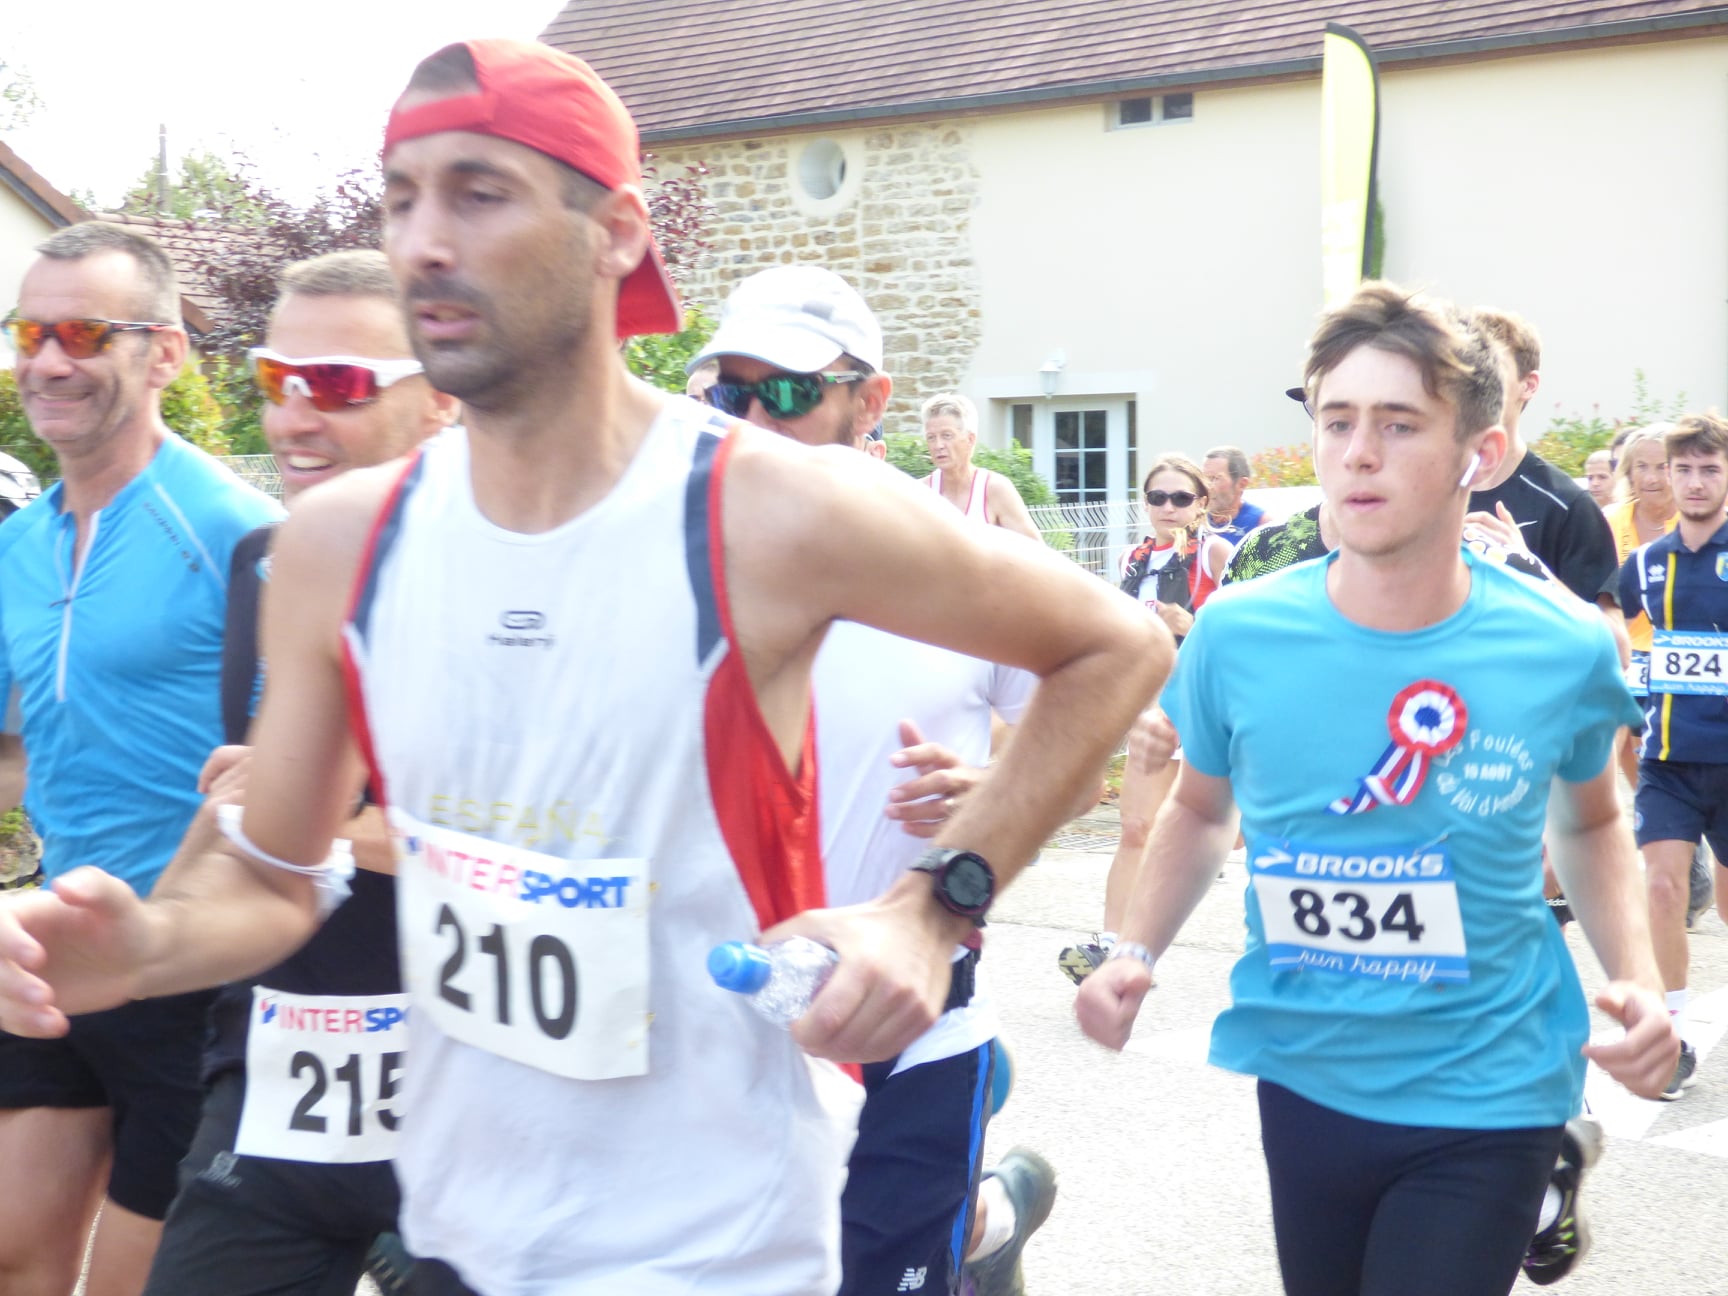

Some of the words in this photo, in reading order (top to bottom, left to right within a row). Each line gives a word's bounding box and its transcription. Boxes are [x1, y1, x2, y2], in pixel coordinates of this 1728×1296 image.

[1666, 651, 1722, 677] 824
[422, 842, 634, 908] INTERSPORT
[1295, 851, 1445, 879] BROOKS
[1289, 888, 1425, 943] 834
[432, 902, 578, 1041] 210
[1350, 955, 1436, 982] happy
[278, 1006, 412, 1034] INTERSP
[288, 1050, 407, 1137] 215
